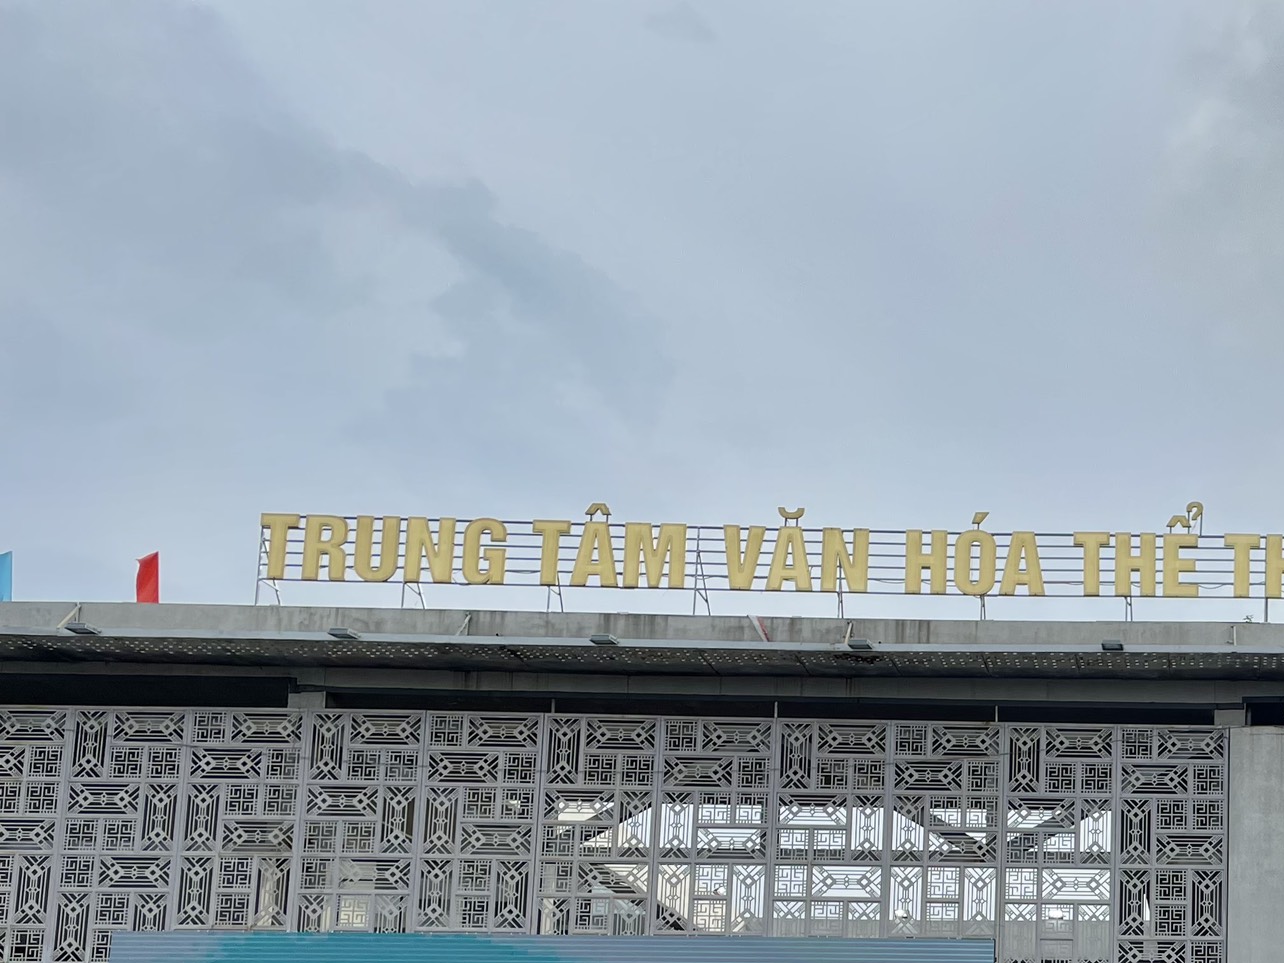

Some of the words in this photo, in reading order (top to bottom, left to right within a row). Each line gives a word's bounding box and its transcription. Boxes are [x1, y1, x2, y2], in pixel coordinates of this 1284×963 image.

[260, 512, 507, 586] TRUNG
[532, 503, 687, 589] TÂM
[723, 507, 870, 593] VĂN
[905, 511, 1045, 597] HÓA
[1073, 501, 1199, 597] THỂ
